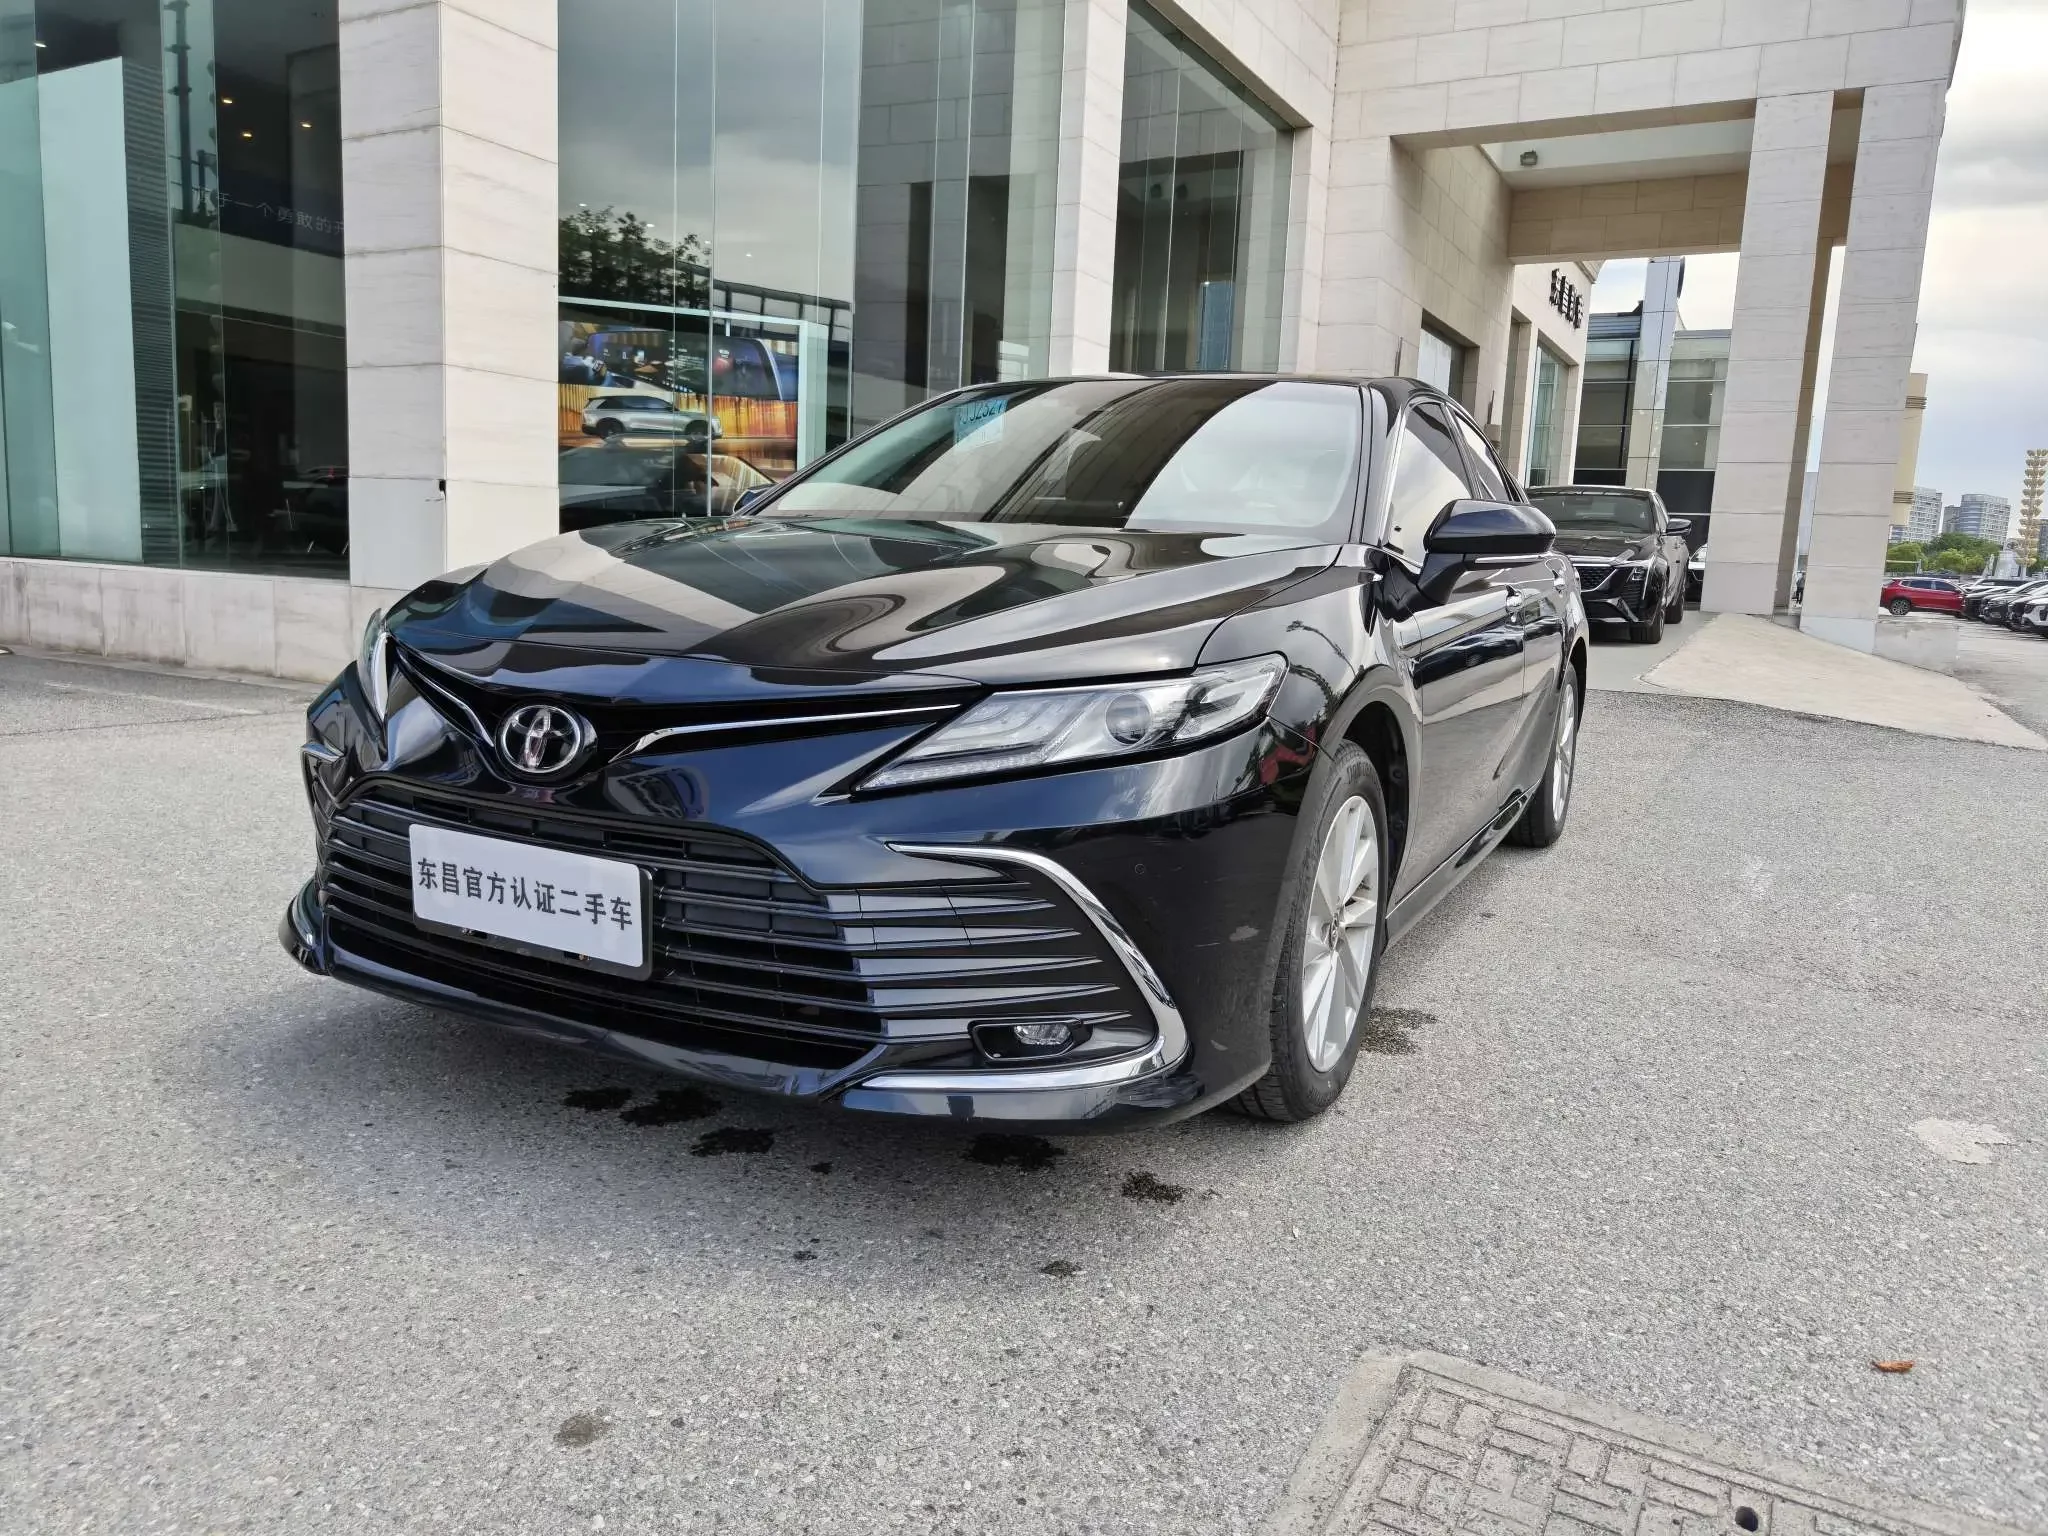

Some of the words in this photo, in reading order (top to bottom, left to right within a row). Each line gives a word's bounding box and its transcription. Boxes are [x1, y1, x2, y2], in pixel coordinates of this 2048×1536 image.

[417, 857, 633, 931] 东昌官方认证二手车
